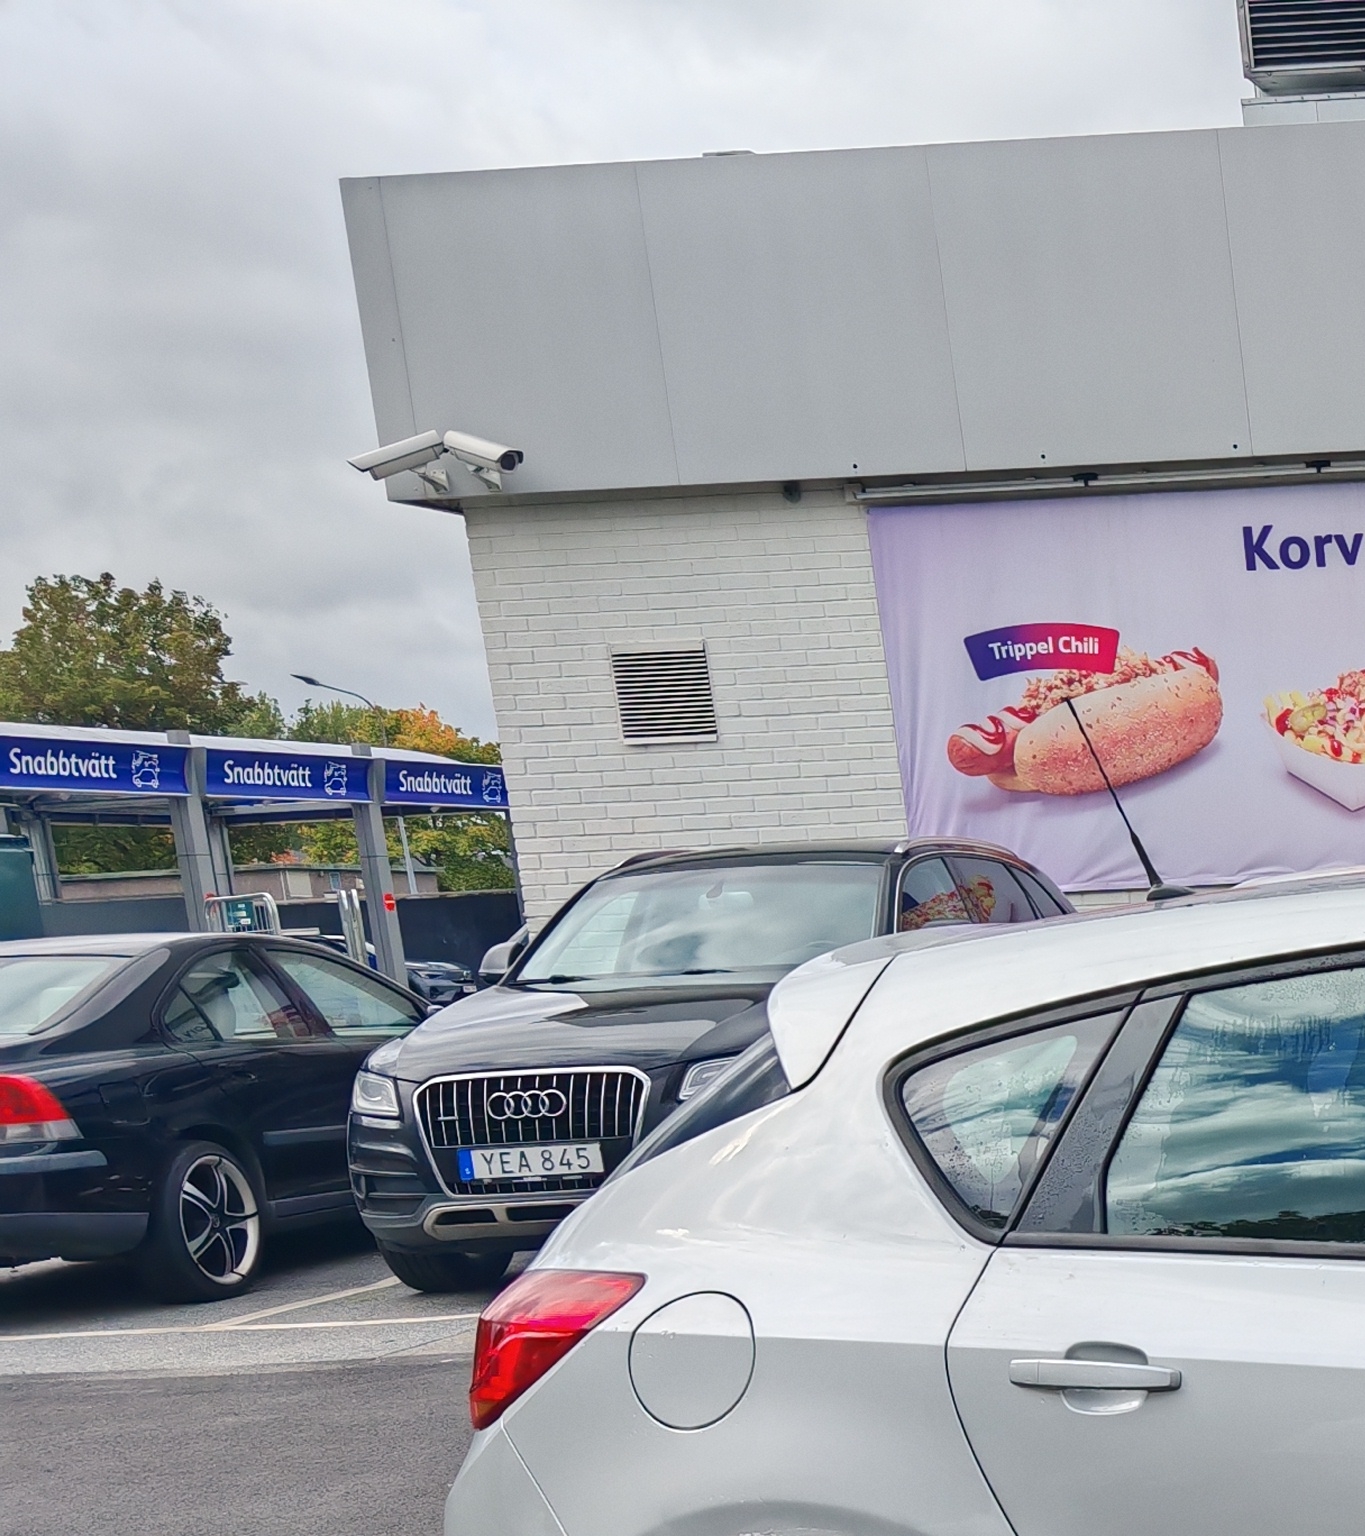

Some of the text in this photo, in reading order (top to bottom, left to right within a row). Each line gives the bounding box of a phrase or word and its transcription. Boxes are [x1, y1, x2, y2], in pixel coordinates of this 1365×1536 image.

[1241, 524, 1362, 572] Korv
[988, 634, 1100, 662] Trippel Chili
[9, 746, 117, 780] Snabbtvätt
[222, 758, 313, 789] Snabbtvätt
[398, 769, 473, 797] Snabbtvätt
[480, 1147, 591, 1175] YEA 845
